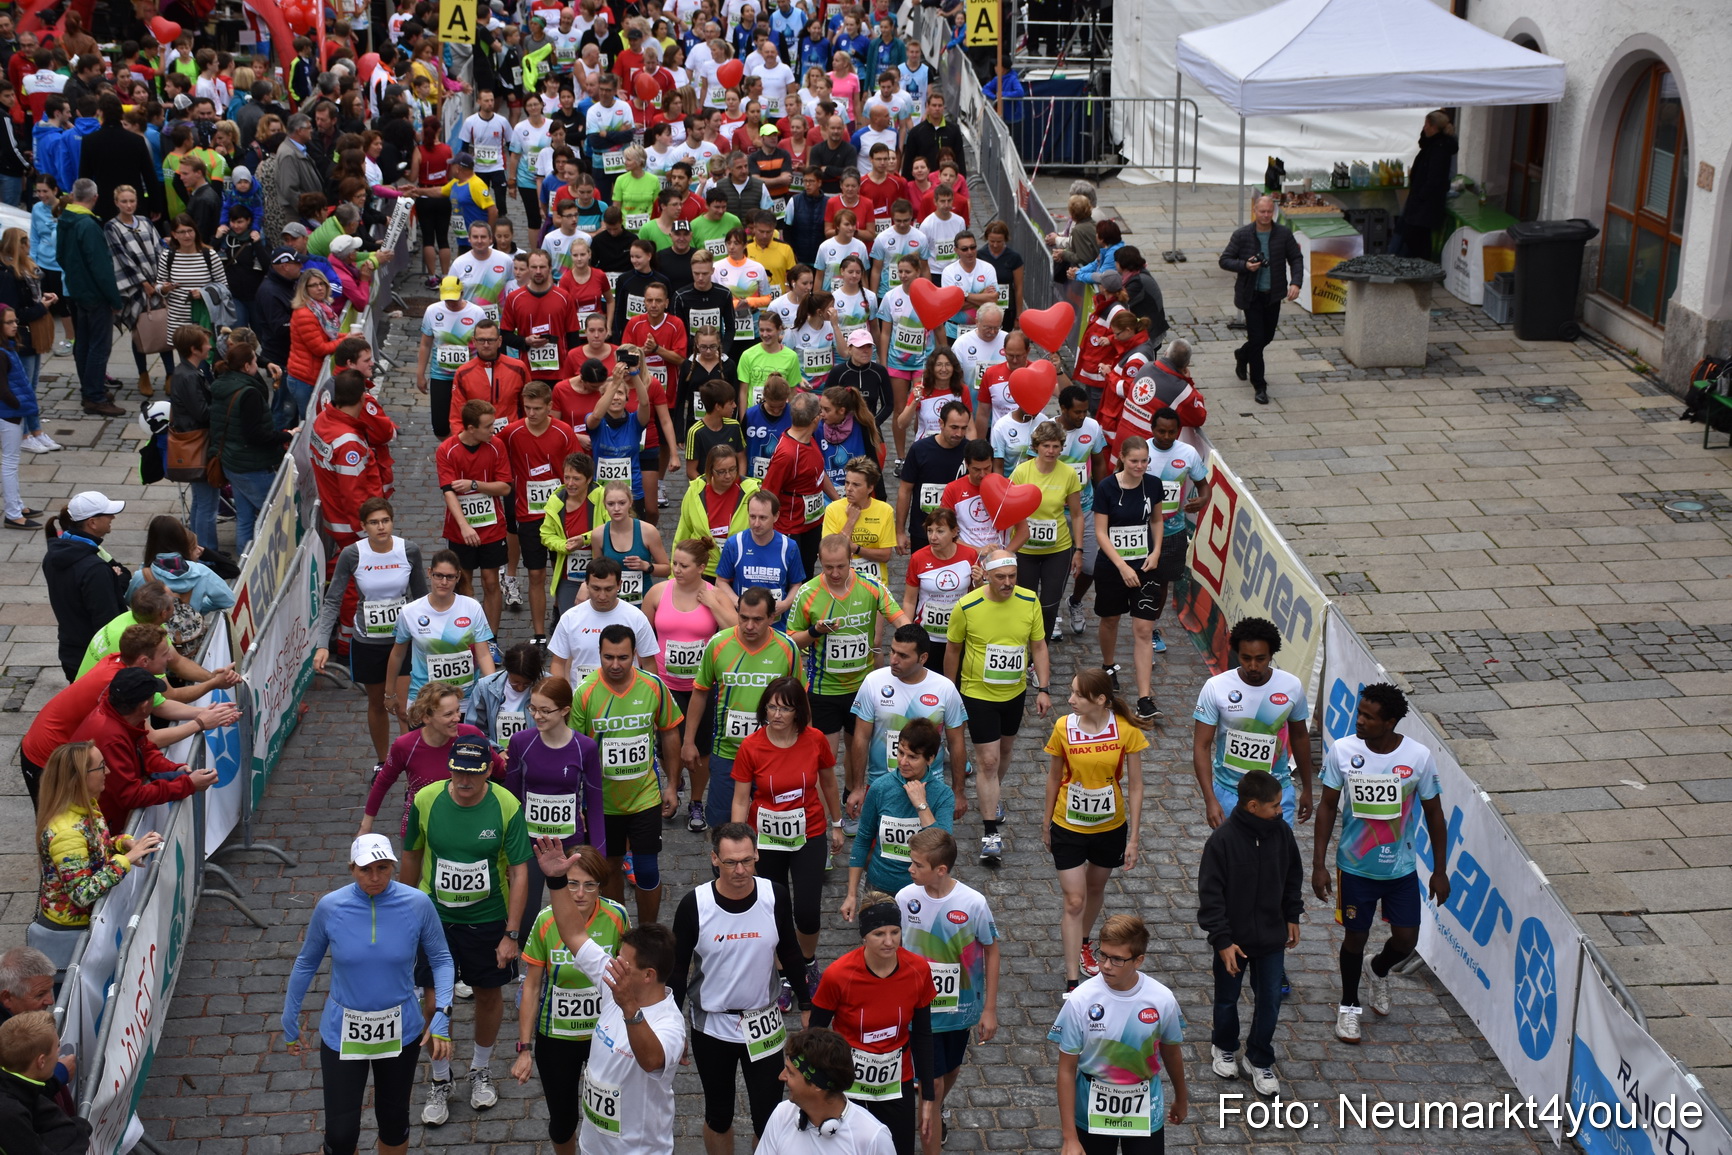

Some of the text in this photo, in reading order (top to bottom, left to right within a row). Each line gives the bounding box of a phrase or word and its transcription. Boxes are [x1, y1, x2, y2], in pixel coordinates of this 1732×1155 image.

[448, 5, 468, 31] A
[975, 8, 993, 33] A
[476, 150, 496, 159] 5312
[771, 201, 785, 212] 198
[708, 244, 726, 255] 530
[938, 244, 954, 254] 502
[629, 302, 646, 314] 533
[693, 315, 718, 327] 5148
[898, 331, 922, 345] 5078
[440, 352, 466, 363] 5103
[530, 349, 555, 361] 5129
[807, 354, 831, 367] 5115
[747, 427, 766, 438] 66
[600, 466, 628, 479] 5324
[1163, 489, 1178, 501] 27
[462, 501, 491, 515] 5062
[1030, 527, 1054, 541] 150
[1114, 534, 1145, 549] 5151
[743, 566, 781, 577] HUBER
[927, 611, 952, 625] 509
[831, 643, 866, 659] 5179
[669, 650, 703, 665] 5024
[989, 655, 1022, 670] 5340
[680, 667, 693, 675] Lisa
[842, 661, 855, 669] Jens
[433, 663, 470, 680] 5053
[723, 672, 783, 687] BOCK
[592, 714, 653, 733] BOCK
[731, 722, 762, 737] 517
[620, 738, 643, 746] Neumarkt
[1245, 735, 1268, 744] Neumarkt
[1069, 742, 1121, 755] MAX BÖGL
[1230, 740, 1270, 761] 5328
[609, 746, 646, 765] 5163
[615, 766, 640, 775] Sleiman
[1354, 785, 1397, 803] 5329
[1072, 795, 1111, 813] 5174
[530, 805, 572, 823] 5068
[537, 825, 562, 834] Natalie
[763, 821, 801, 837] 5101
[893, 846, 911, 855] Claud
[438, 862, 454, 870] PARTL
[441, 872, 485, 891] 5023
[453, 892, 470, 903] Jörg
[727, 933, 762, 941] KLEBL
[936, 976, 955, 994] 30
[345, 1013, 393, 1022] PARTL Neumarkt
[570, 1020, 594, 1029] Ulrike
[348, 1021, 395, 1041] 5341
[872, 1031, 888, 1040] DEHN
[871, 1056, 896, 1065] Neumarkt
[855, 1063, 898, 1083] 5067
[860, 1085, 887, 1095] Kathrin
[1092, 1083, 1141, 1095] PARTL Neumarkt
[1096, 1094, 1144, 1115] 5007
[1104, 1118, 1133, 1129] Florian
